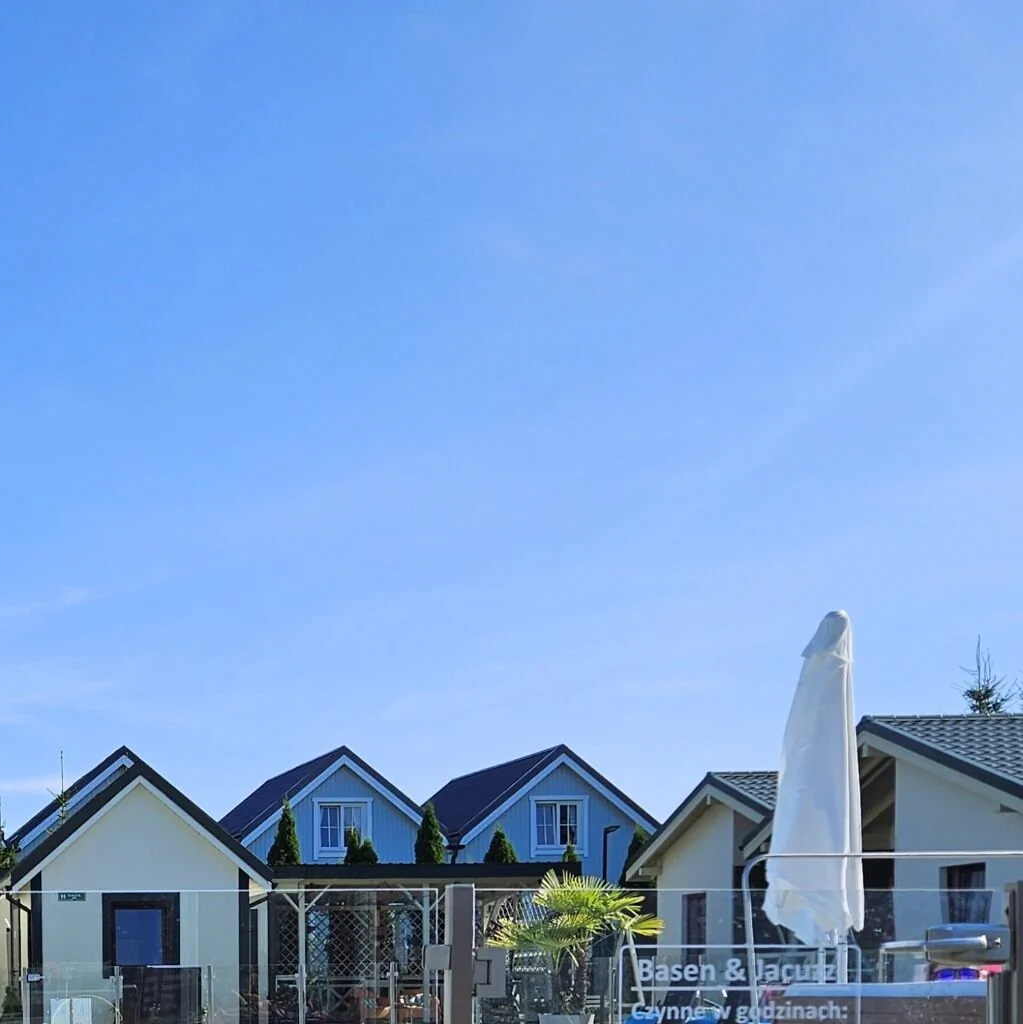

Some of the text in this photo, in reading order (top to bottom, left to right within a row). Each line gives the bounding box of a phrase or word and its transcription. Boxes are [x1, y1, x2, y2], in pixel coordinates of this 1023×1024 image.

[638, 958, 843, 981] Basen & Jacuzz
[632, 1004, 706, 1024] Czynne
[735, 1001, 848, 1024] godzinach:
